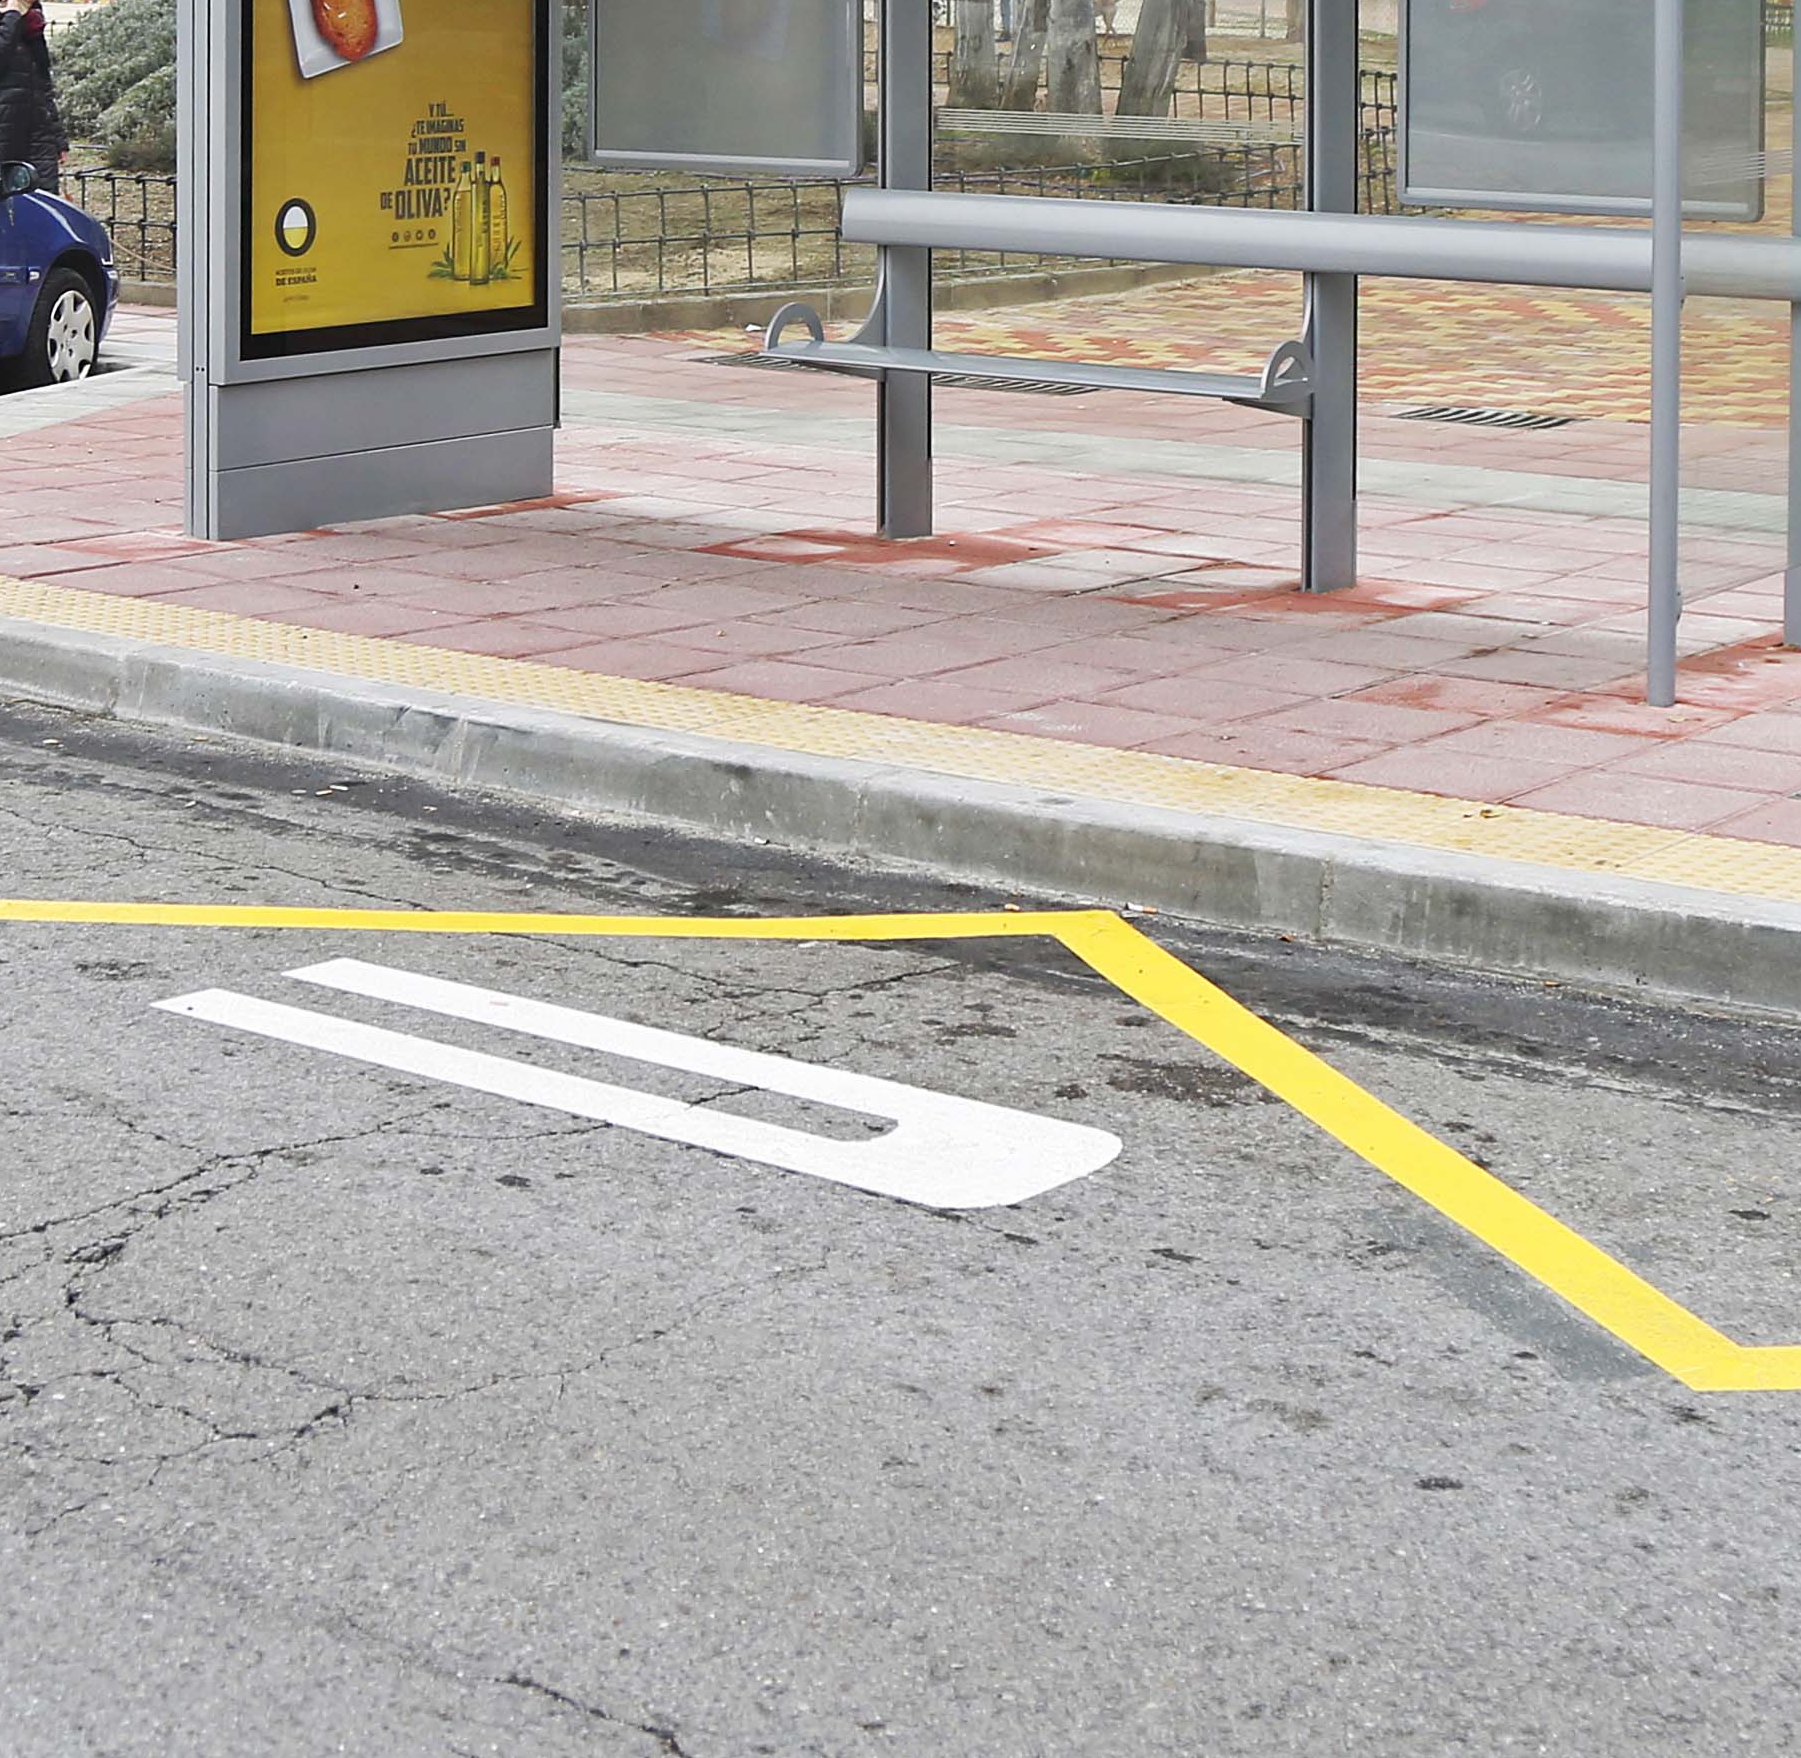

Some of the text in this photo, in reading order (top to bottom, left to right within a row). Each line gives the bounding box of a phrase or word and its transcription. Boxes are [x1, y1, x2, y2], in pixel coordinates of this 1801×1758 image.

[429, 102, 436, 118] Y
[426, 118, 465, 135] IMAGINAS
[418, 135, 453, 154] MUNDO
[404, 155, 457, 187] ACEITE
[380, 191, 393, 211] DE
[394, 187, 451, 221] OLIVA?
